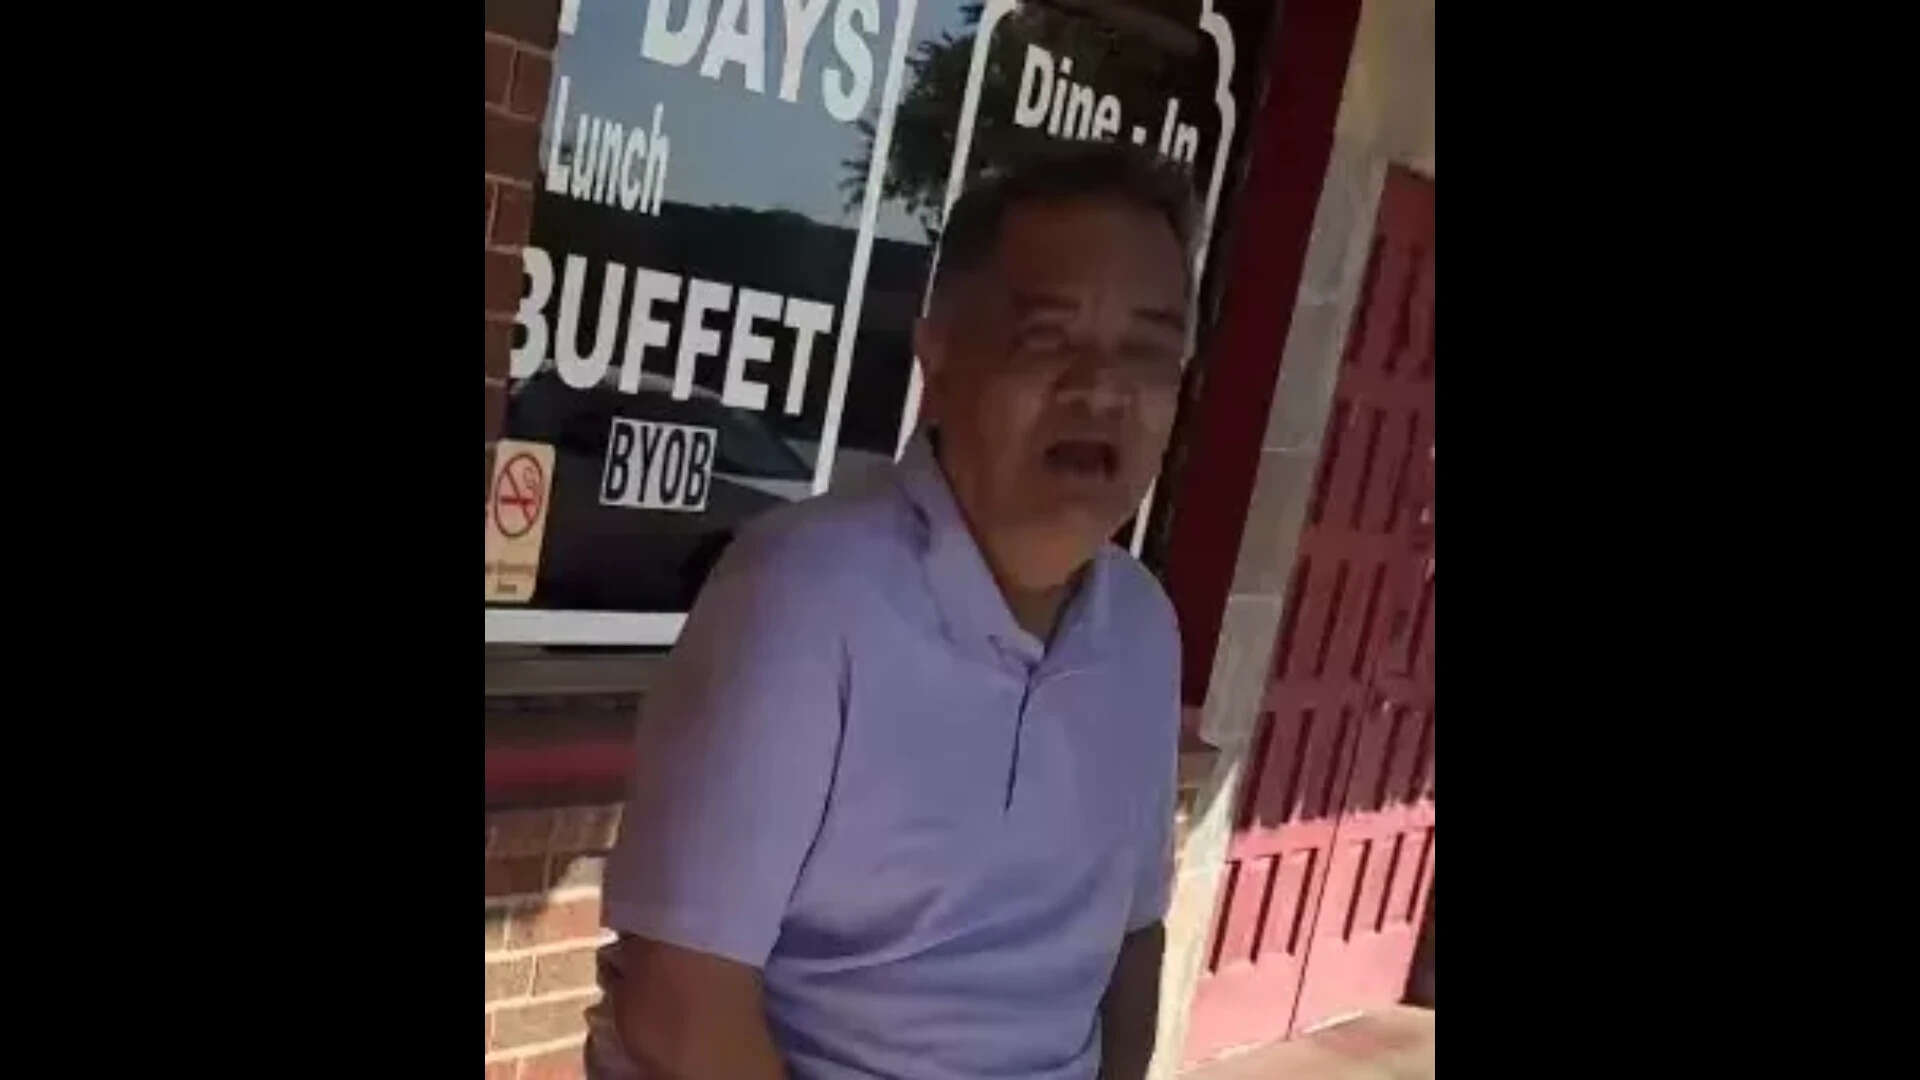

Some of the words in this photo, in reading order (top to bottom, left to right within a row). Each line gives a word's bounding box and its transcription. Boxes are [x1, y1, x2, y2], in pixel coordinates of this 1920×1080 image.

[641, 0, 879, 122] DAYS
[1014, 43, 1121, 143] Dine
[545, 76, 670, 216] Lunch
[509, 246, 835, 416] BUFFET
[605, 421, 713, 507] BYOB
